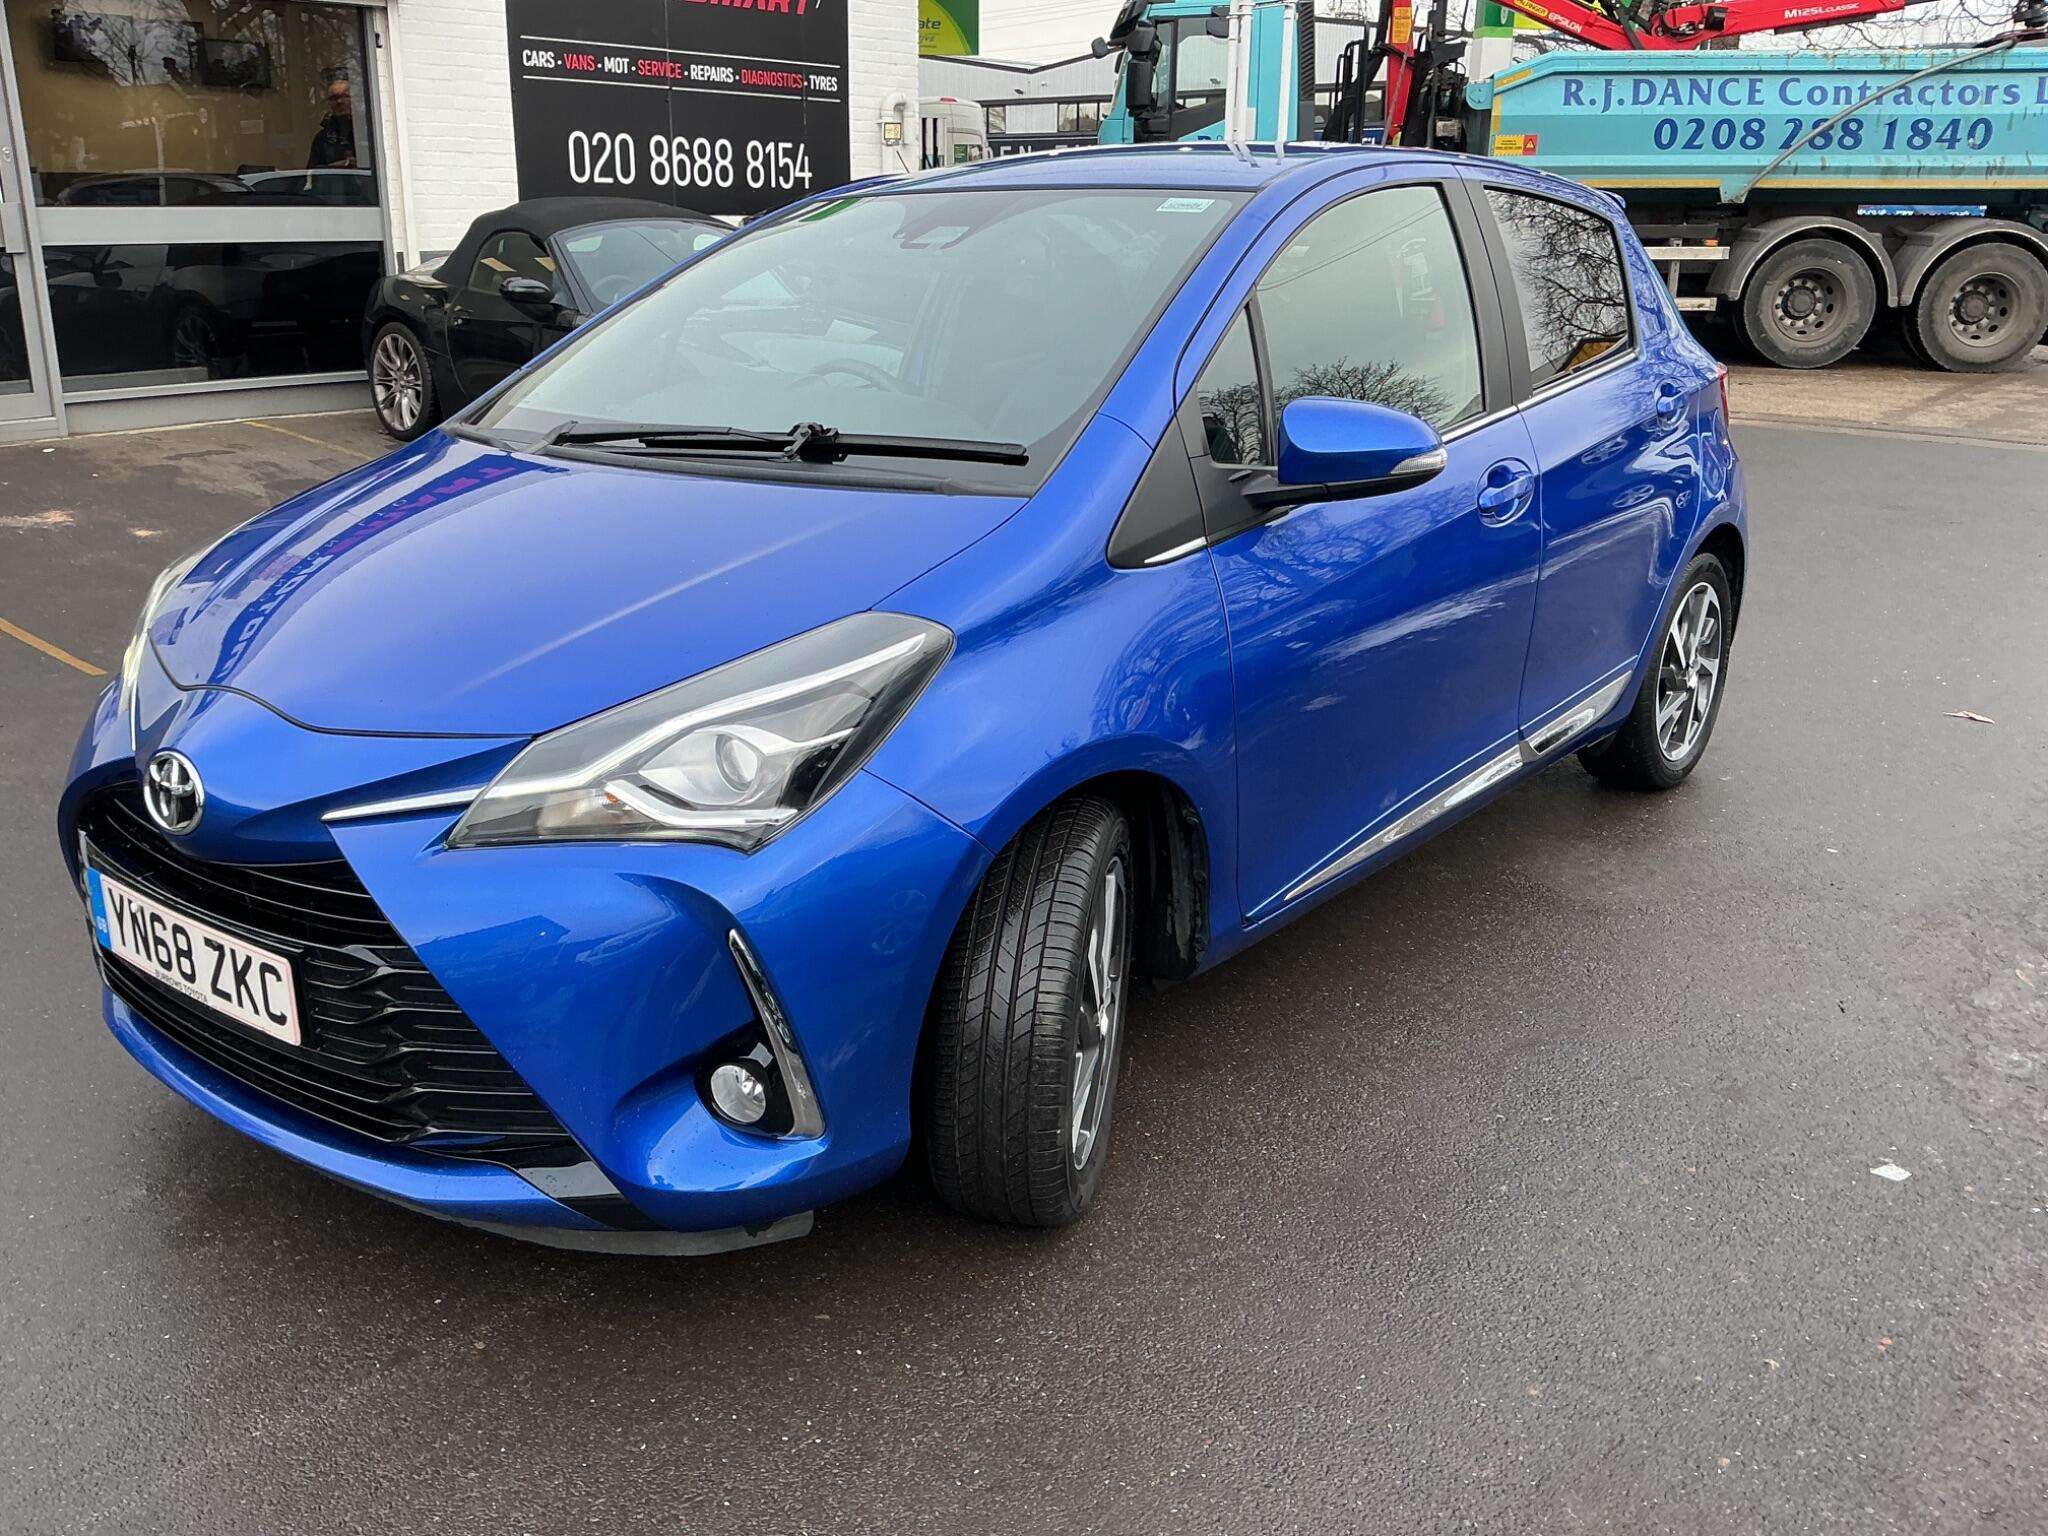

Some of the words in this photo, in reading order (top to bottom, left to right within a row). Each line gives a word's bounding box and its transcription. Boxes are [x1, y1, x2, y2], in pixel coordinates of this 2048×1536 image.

[1548, 12, 1582, 33] EPSILON
[522, 50, 555, 68] CARS
[563, 53, 596, 71] VANS
[604, 56, 629, 74] MOT
[637, 59, 682, 79] SERVICE
[690, 64, 734, 83] REPAIRS
[740, 69, 803, 88] DIAGNOSTICS
[809, 75, 838, 91] TYRES
[1778, 77, 2021, 107] Contractors
[1653, 118, 1767, 151] 0208
[1778, 118, 1864, 151] 288
[1882, 117, 1994, 151] 1840
[568, 130, 636, 185] 020
[649, 134, 734, 188] 8688
[746, 140, 812, 190] 8154
[107, 887, 197, 985] YN68
[202, 935, 288, 1026] ZKC
